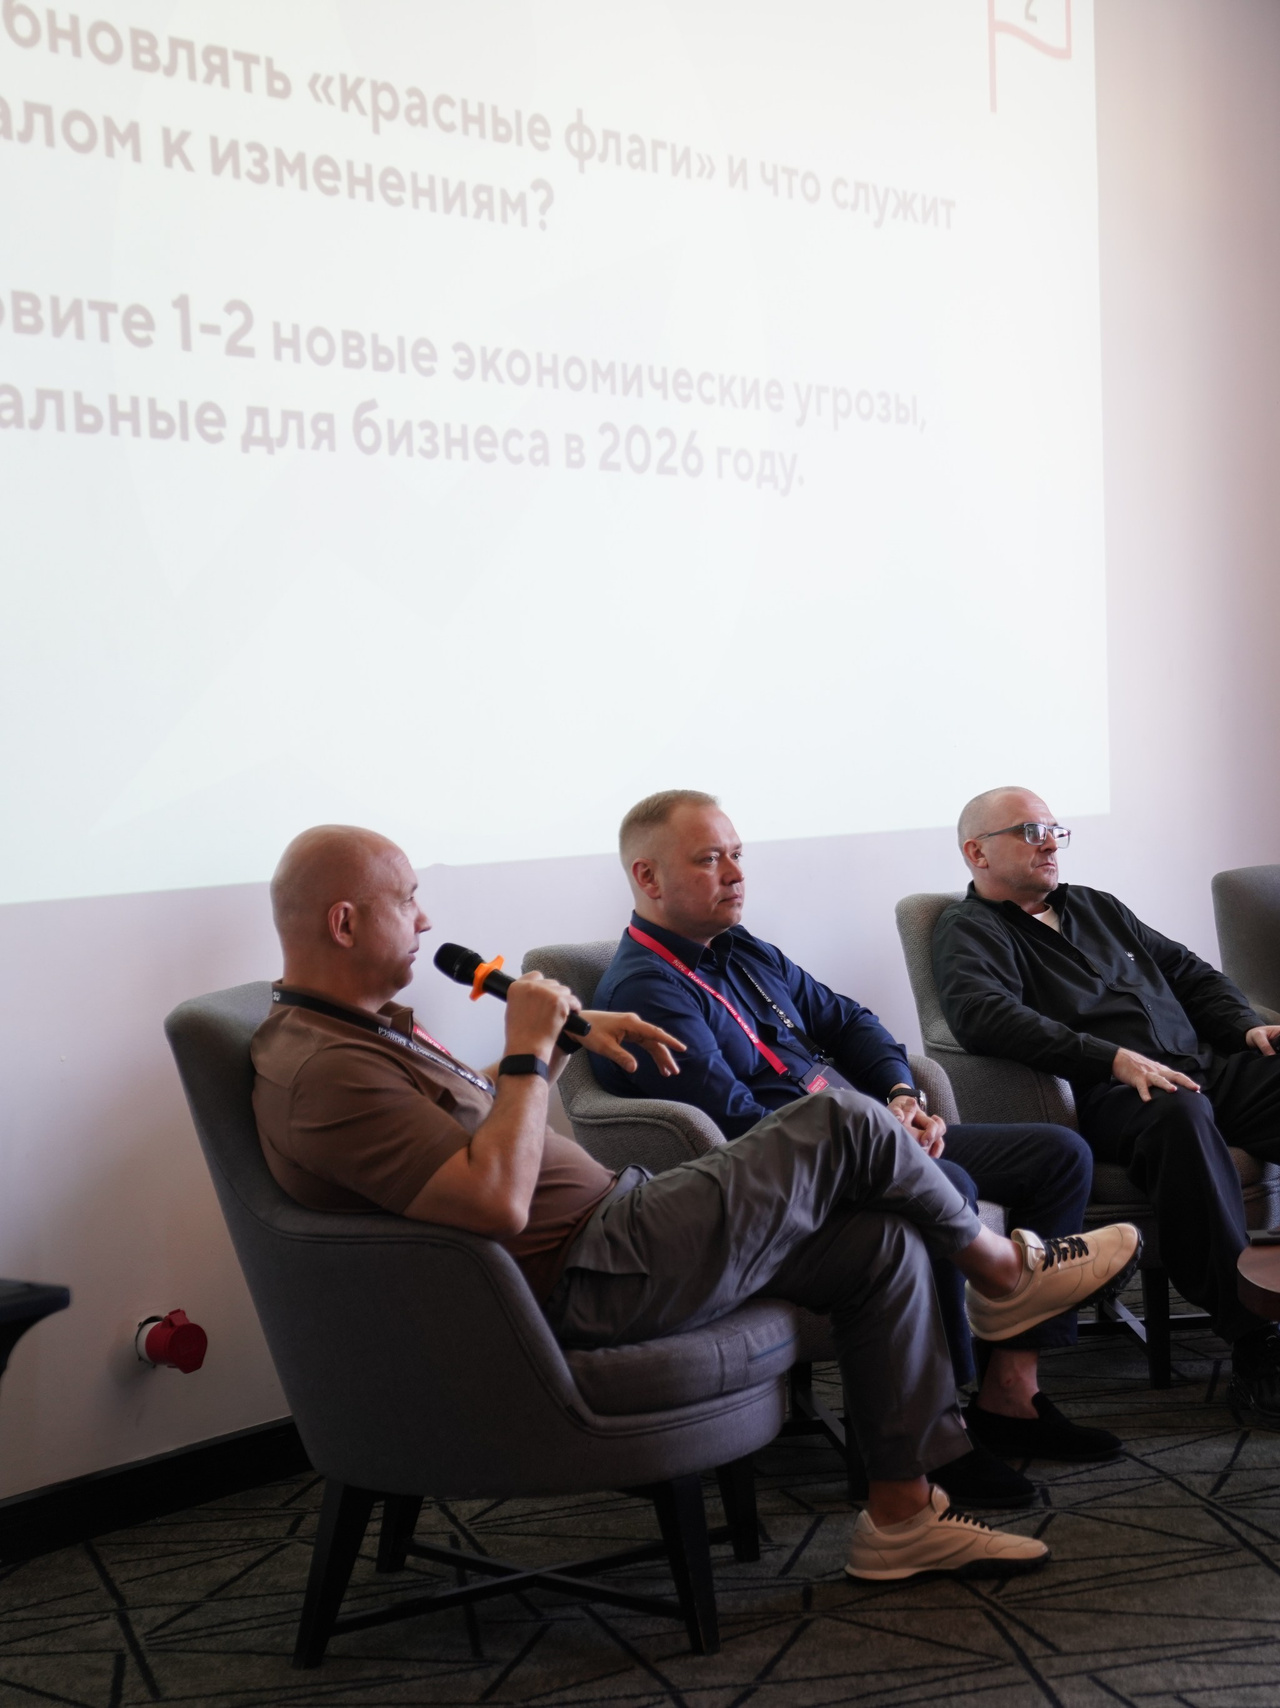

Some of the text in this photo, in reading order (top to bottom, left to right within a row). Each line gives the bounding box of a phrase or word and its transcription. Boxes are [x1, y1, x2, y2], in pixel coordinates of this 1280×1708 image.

[161, 125, 195, 173] к
[209, 134, 554, 232] изменениям?
[307, 72, 551, 152] «красные
[564, 108, 716, 181] флаги»
[728, 156, 749, 191] и
[759, 160, 821, 204] что
[831, 177, 956, 230] служит
[0, 289, 927, 433] вите 1-2 новые экономические угрозы,
[0, 383, 804, 498] альные для бизнеса в 2026 году.
